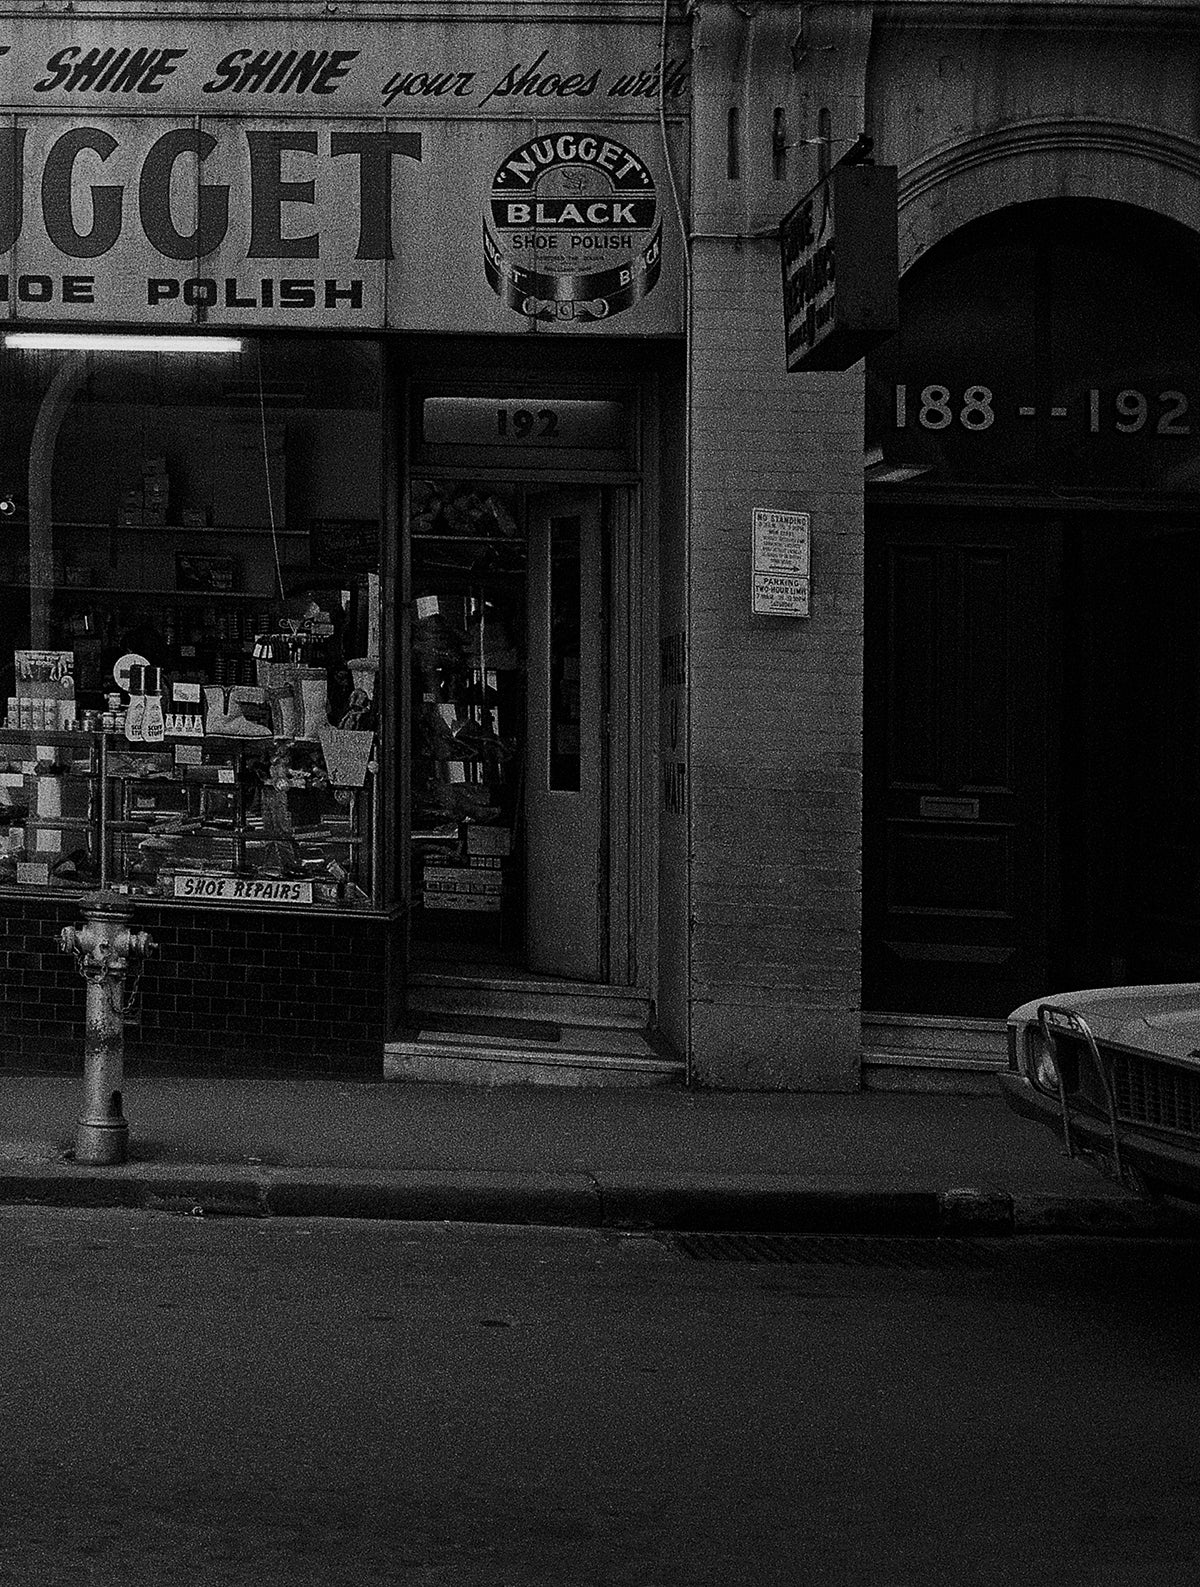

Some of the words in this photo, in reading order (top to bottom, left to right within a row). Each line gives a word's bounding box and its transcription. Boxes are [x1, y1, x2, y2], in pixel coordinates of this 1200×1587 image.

[32, 46, 188, 94] SHINE
[202, 48, 360, 95] SHINE
[381, 70, 476, 108] your
[479, 49, 601, 108] shoes
[506, 202, 637, 224] BLACK
[512, 234, 558, 249] SHOE
[571, 235, 632, 249] POLISH
[147, 278, 363, 309] POLISH
[497, 408, 560, 439] 192
[896, 384, 995, 431] 188
[1090, 388, 1192, 435] 192
[184, 878, 226, 896] SHOE
[234, 881, 301, 900] REPAIRS
